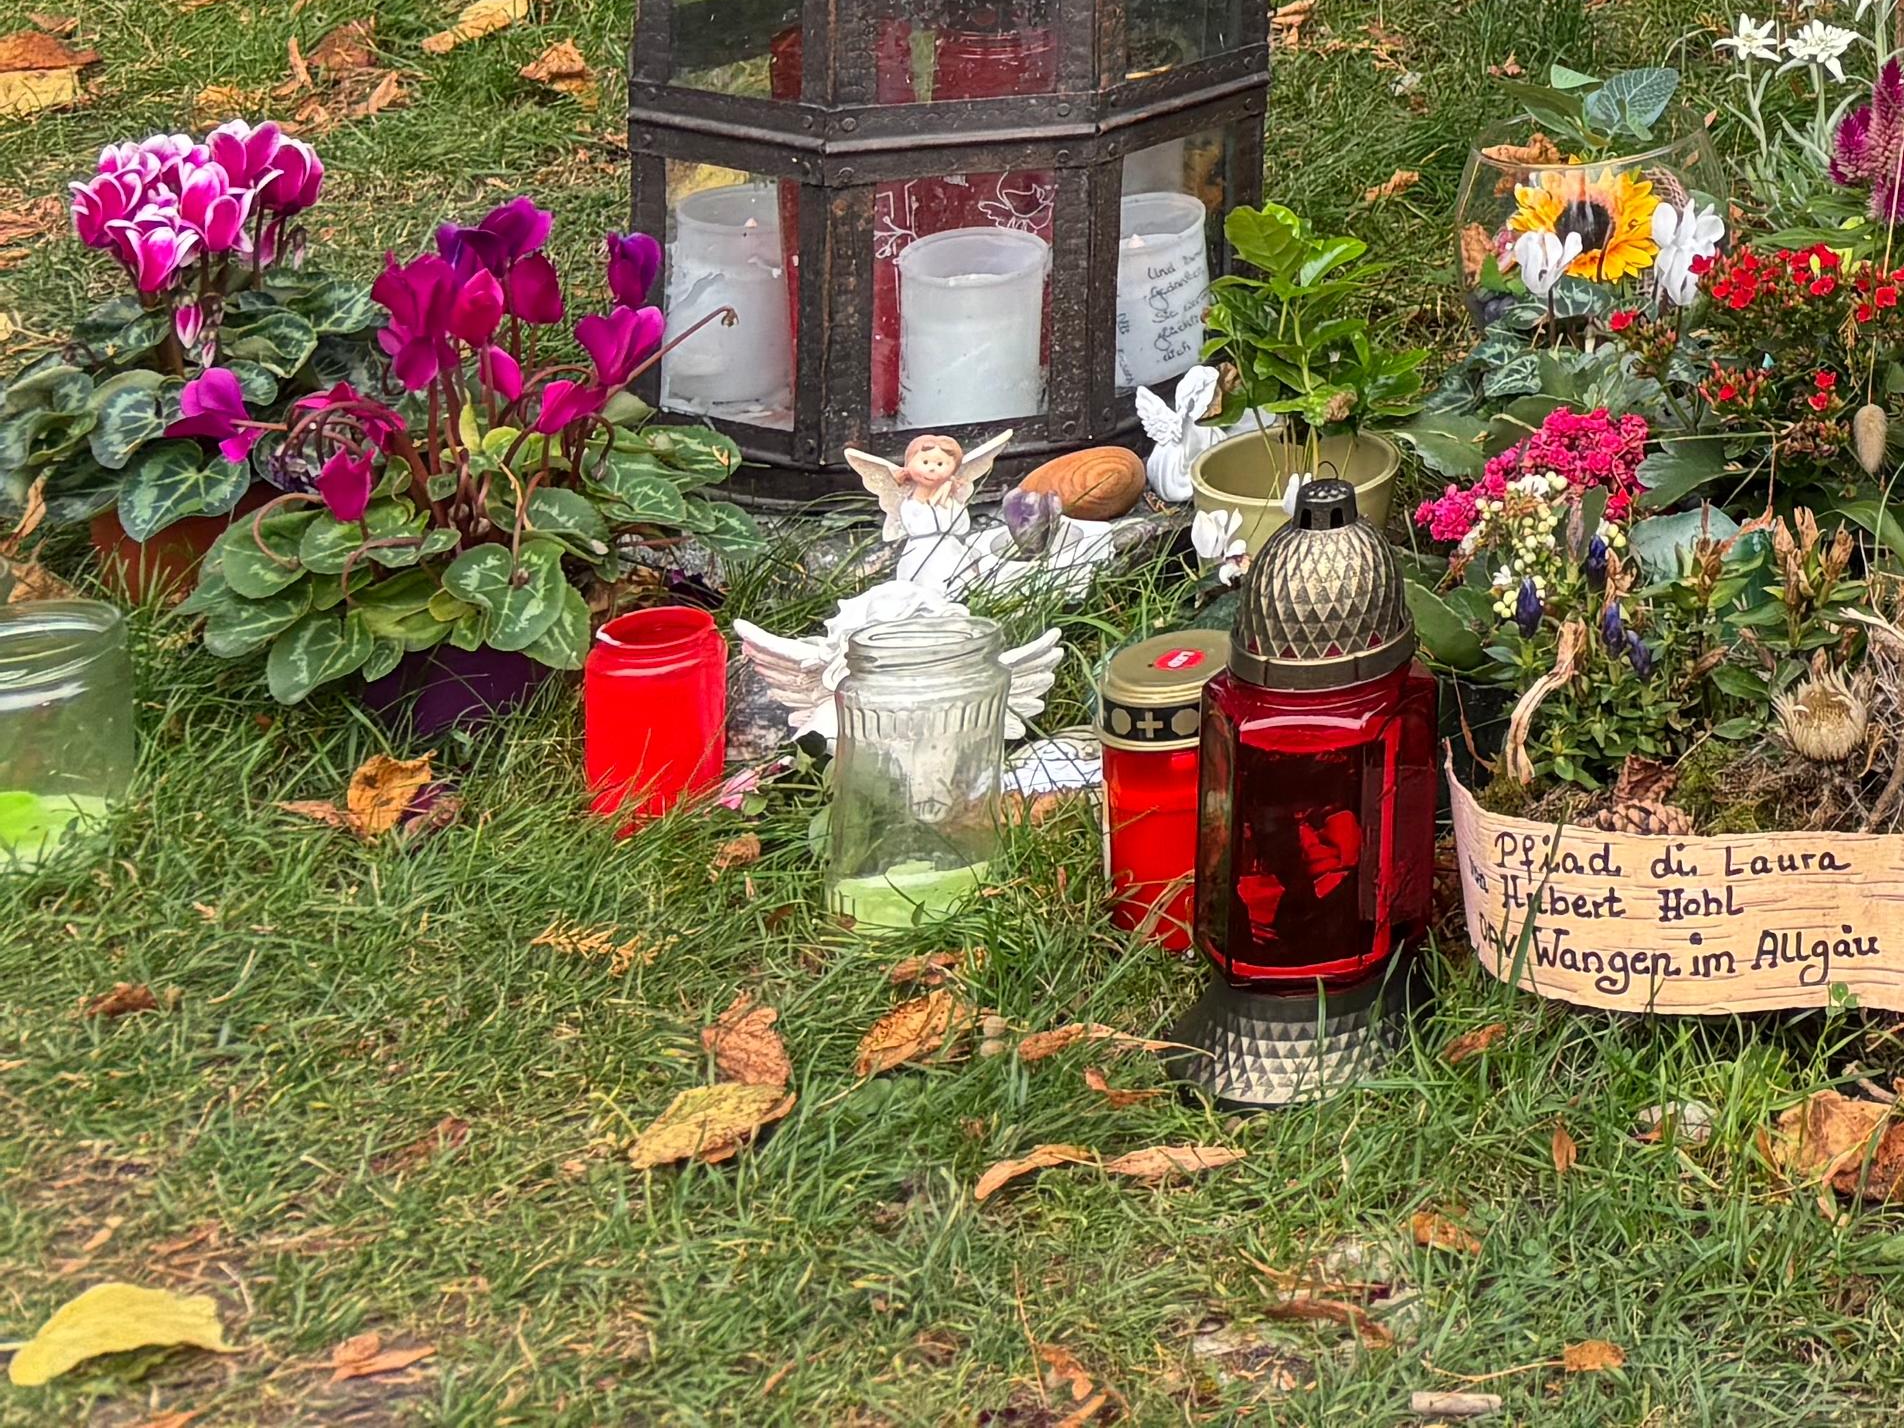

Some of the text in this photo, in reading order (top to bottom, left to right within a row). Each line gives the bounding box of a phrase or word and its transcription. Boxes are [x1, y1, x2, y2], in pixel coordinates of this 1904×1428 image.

[1493, 830, 1624, 885] Pfiad
[1723, 844, 1853, 875] Laura
[1499, 874, 1628, 920] Hubert
[1658, 884, 1746, 923] Hohl
[1531, 926, 1681, 996] Wangen
[1689, 930, 1738, 978] im
